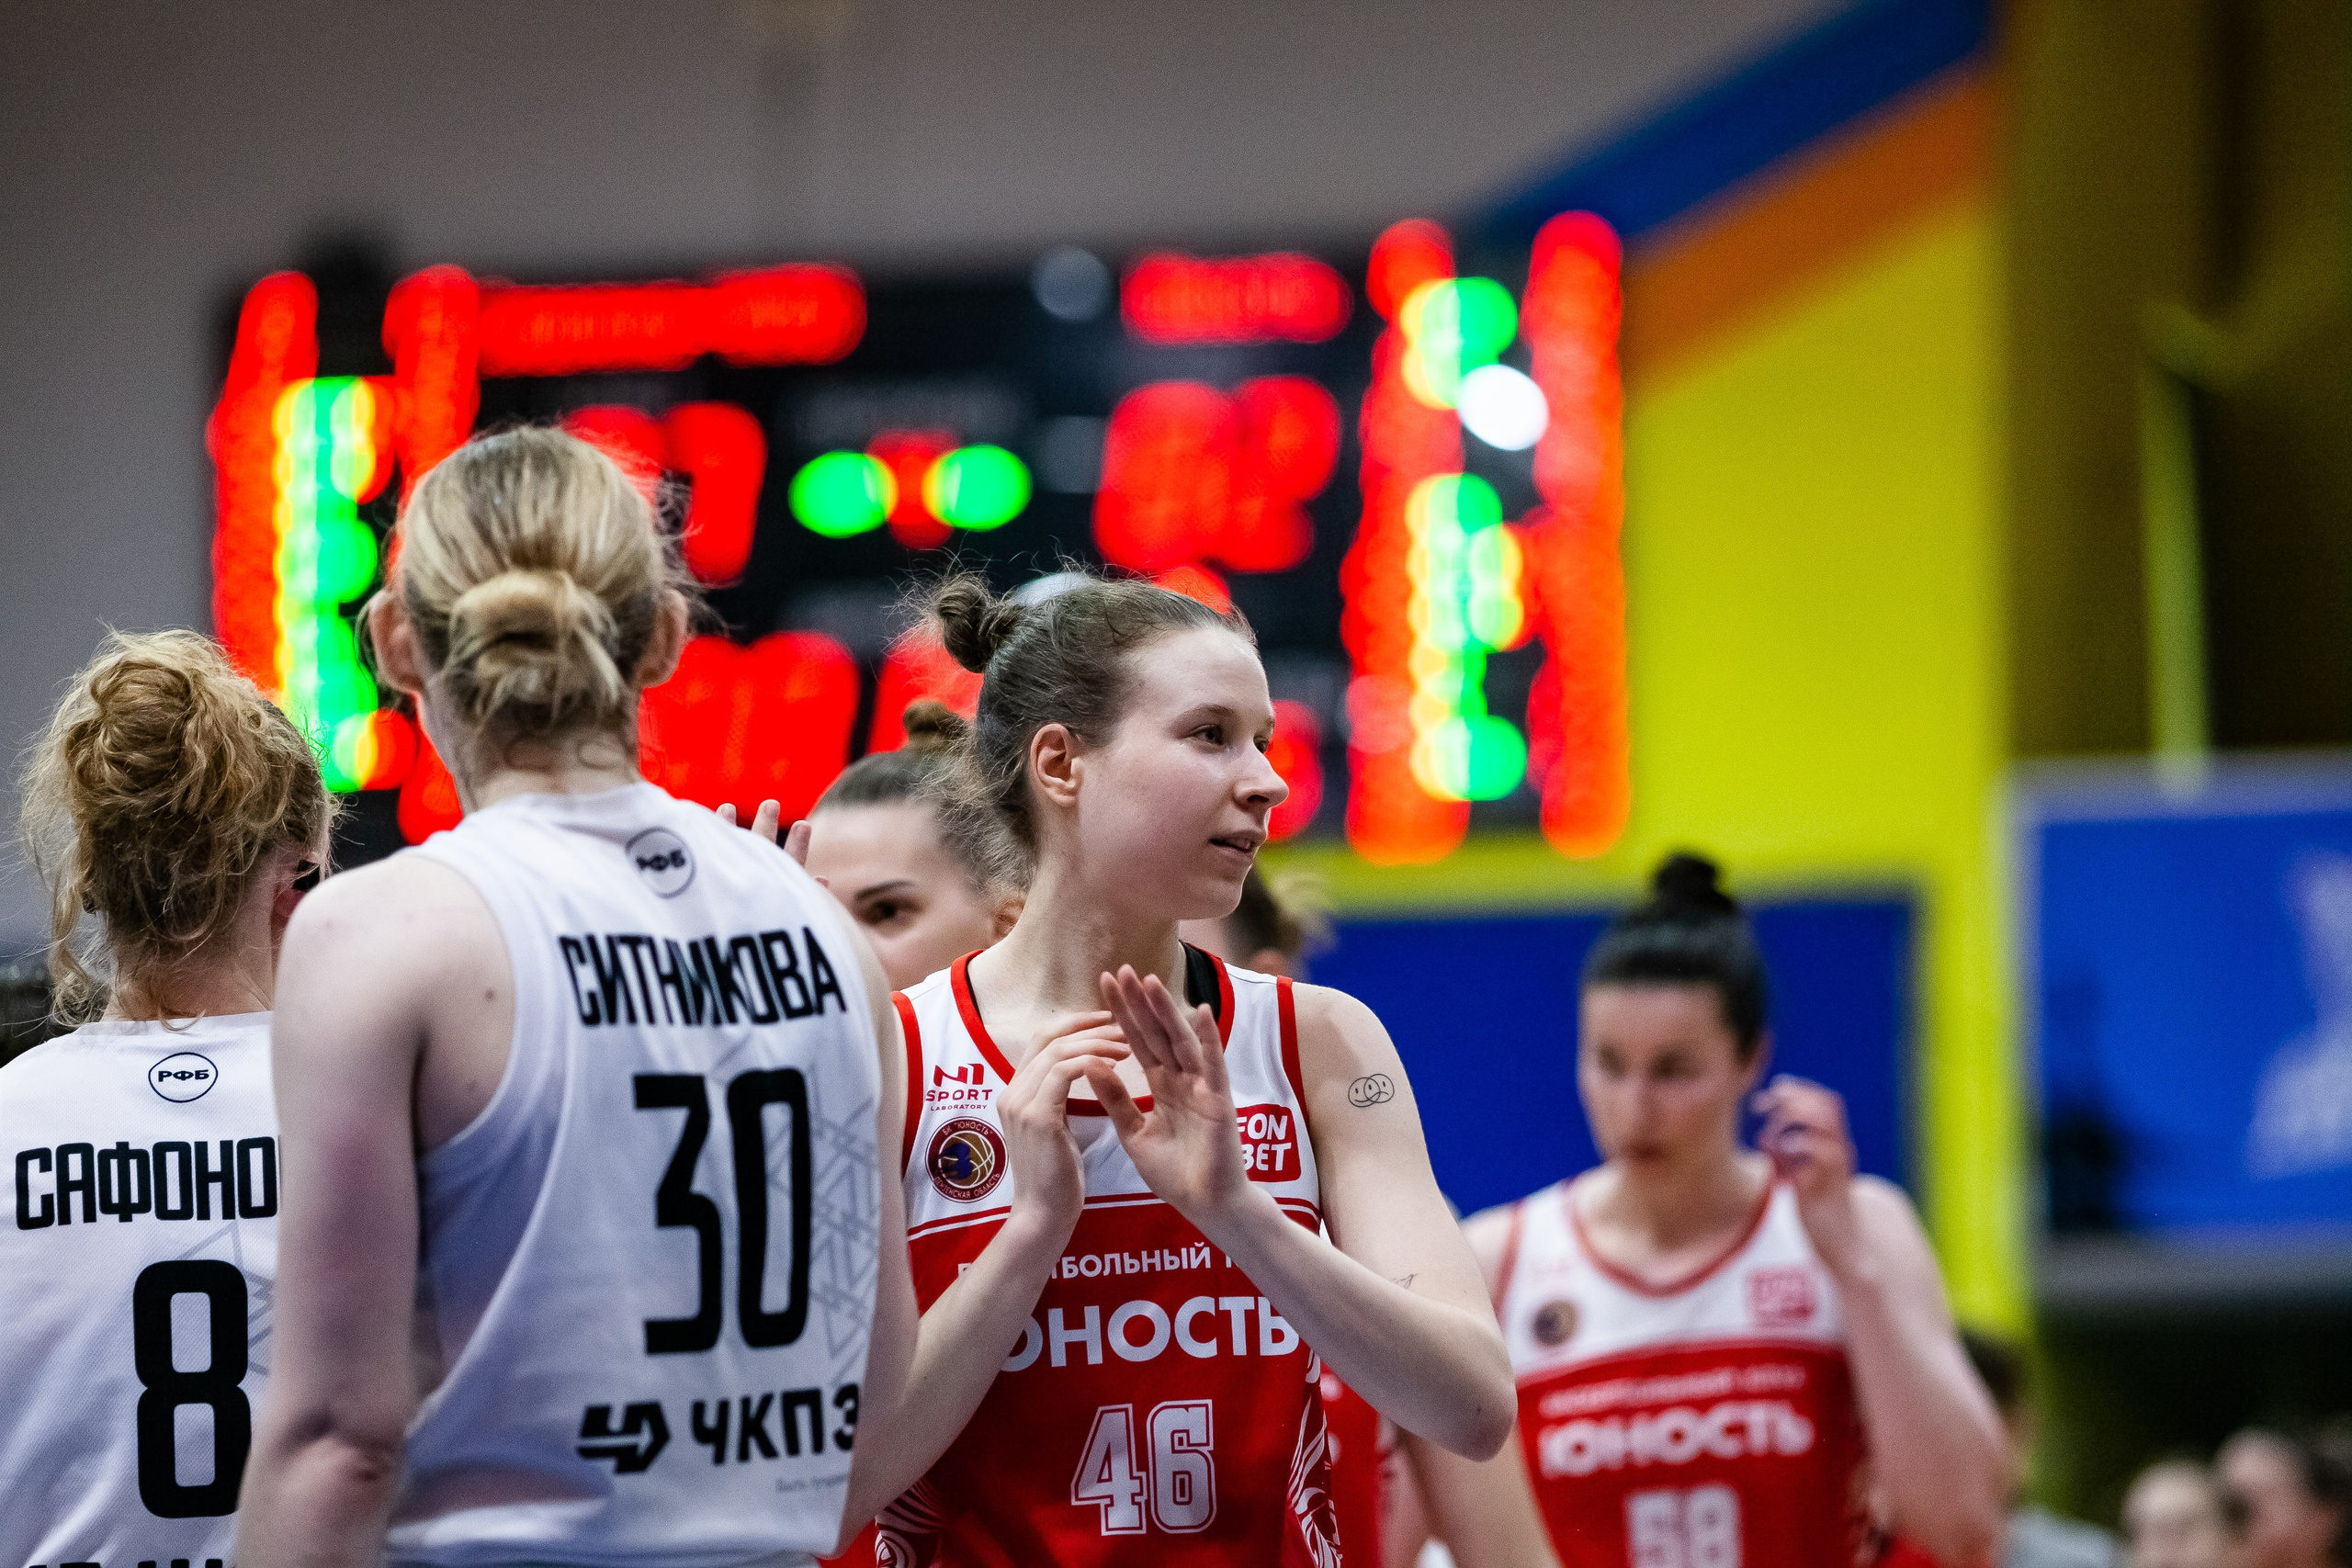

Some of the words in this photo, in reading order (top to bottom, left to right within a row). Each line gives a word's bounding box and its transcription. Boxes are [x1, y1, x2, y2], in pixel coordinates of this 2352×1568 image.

[559, 927, 846, 1027] СИТНИКОВА
[158, 1070, 209, 1082] РФБ
[926, 1089, 992, 1101] SPORT
[16, 1137, 281, 1231] САФОНО
[633, 1067, 812, 1355] 30
[133, 1259, 252, 1518] 8
[1070, 1398, 1217, 1537] 46
